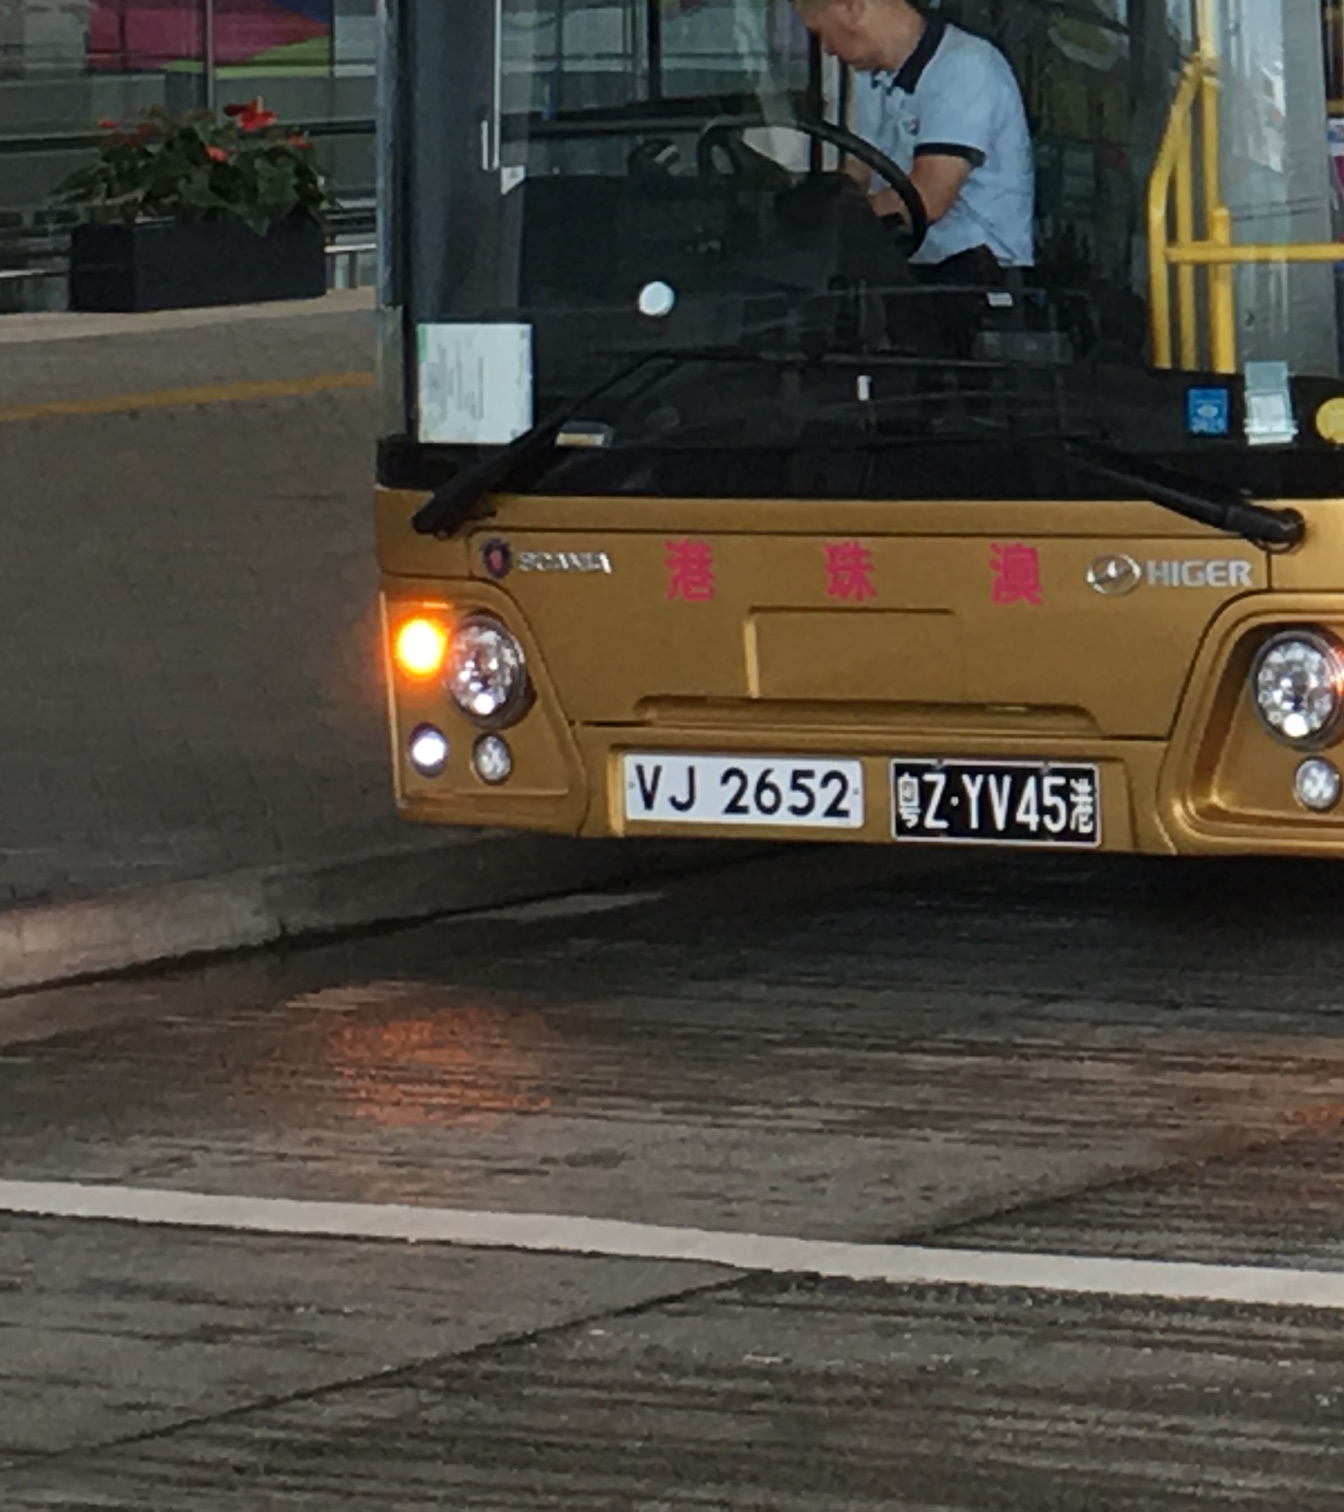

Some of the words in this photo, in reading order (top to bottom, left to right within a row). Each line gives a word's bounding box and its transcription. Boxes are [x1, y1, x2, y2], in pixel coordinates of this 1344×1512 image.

[1147, 559, 1253, 588] HIGER
[635, 763, 698, 813] VJ
[719, 767, 851, 819] 2652
